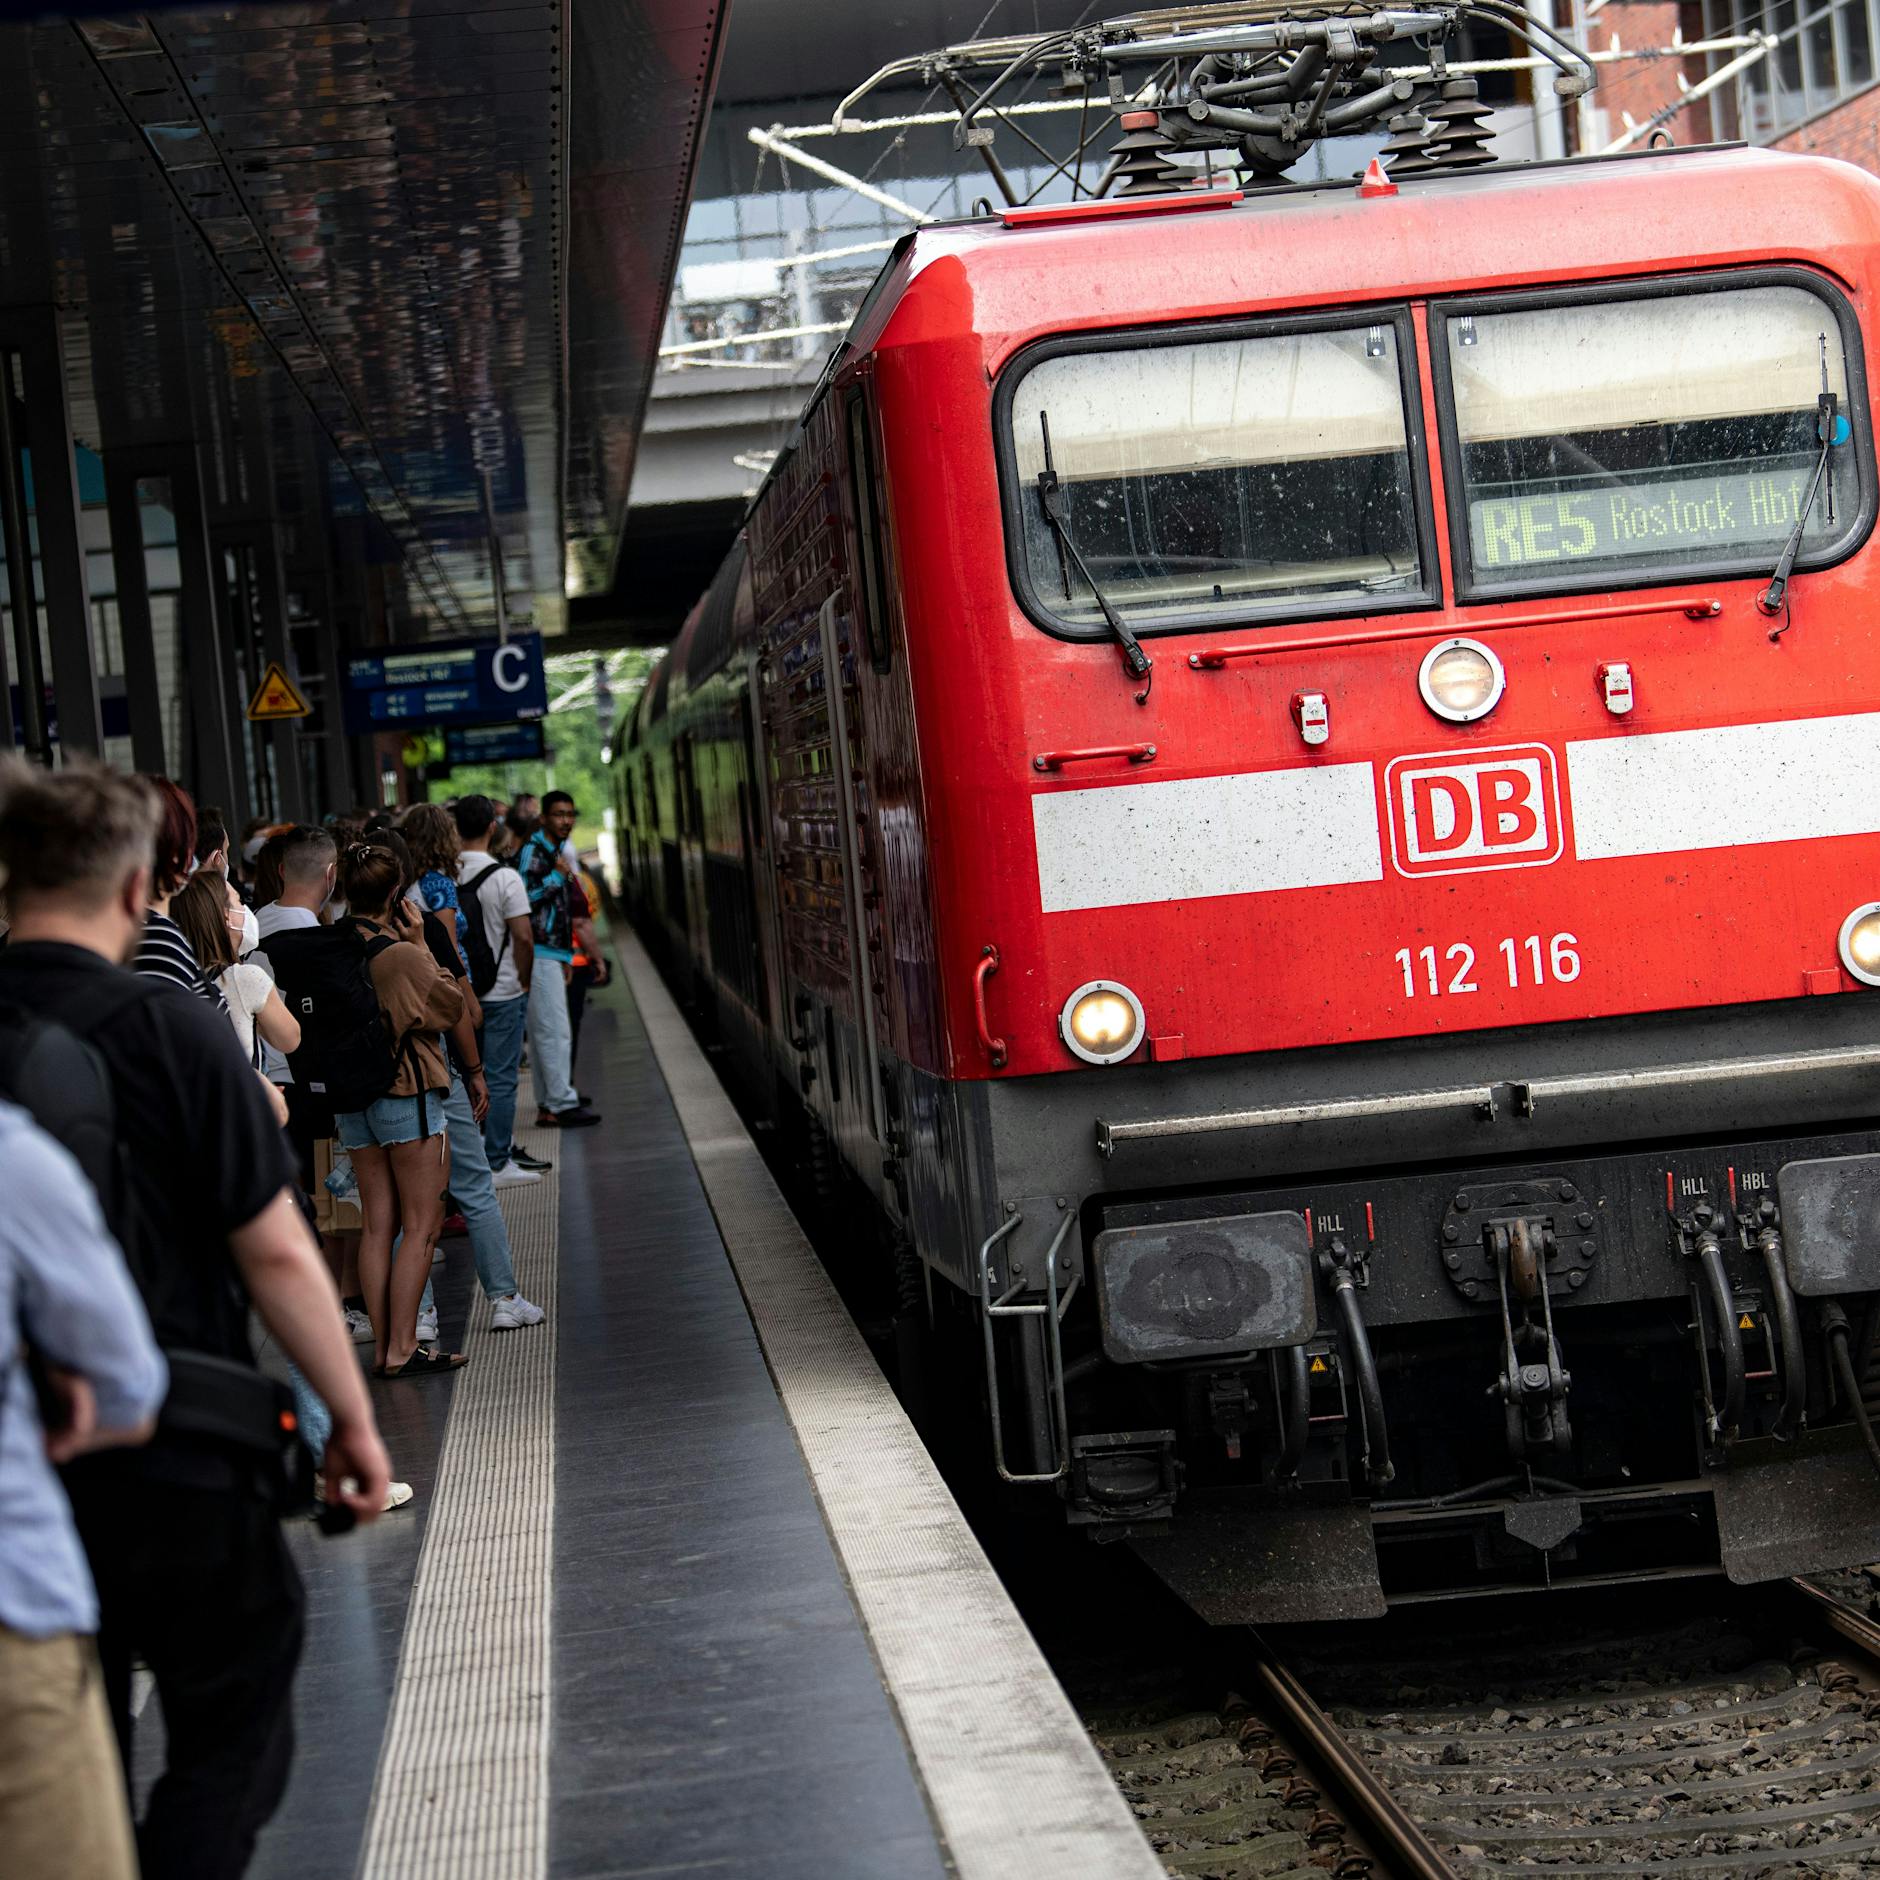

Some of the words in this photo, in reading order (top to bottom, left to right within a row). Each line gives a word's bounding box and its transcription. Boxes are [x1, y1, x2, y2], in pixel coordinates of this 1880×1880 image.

[1482, 494, 1597, 565] RE5
[1609, 482, 1736, 541] Rostock
[1749, 476, 1801, 527] Hbf
[491, 644, 530, 693] C
[1411, 768, 1538, 854] DB
[1394, 942, 1479, 998] 112
[1498, 931, 1581, 988] 116
[1681, 1176, 1709, 1196] HLL
[1741, 1171, 1770, 1191] HBL
[1317, 1214, 1345, 1233] HLL
